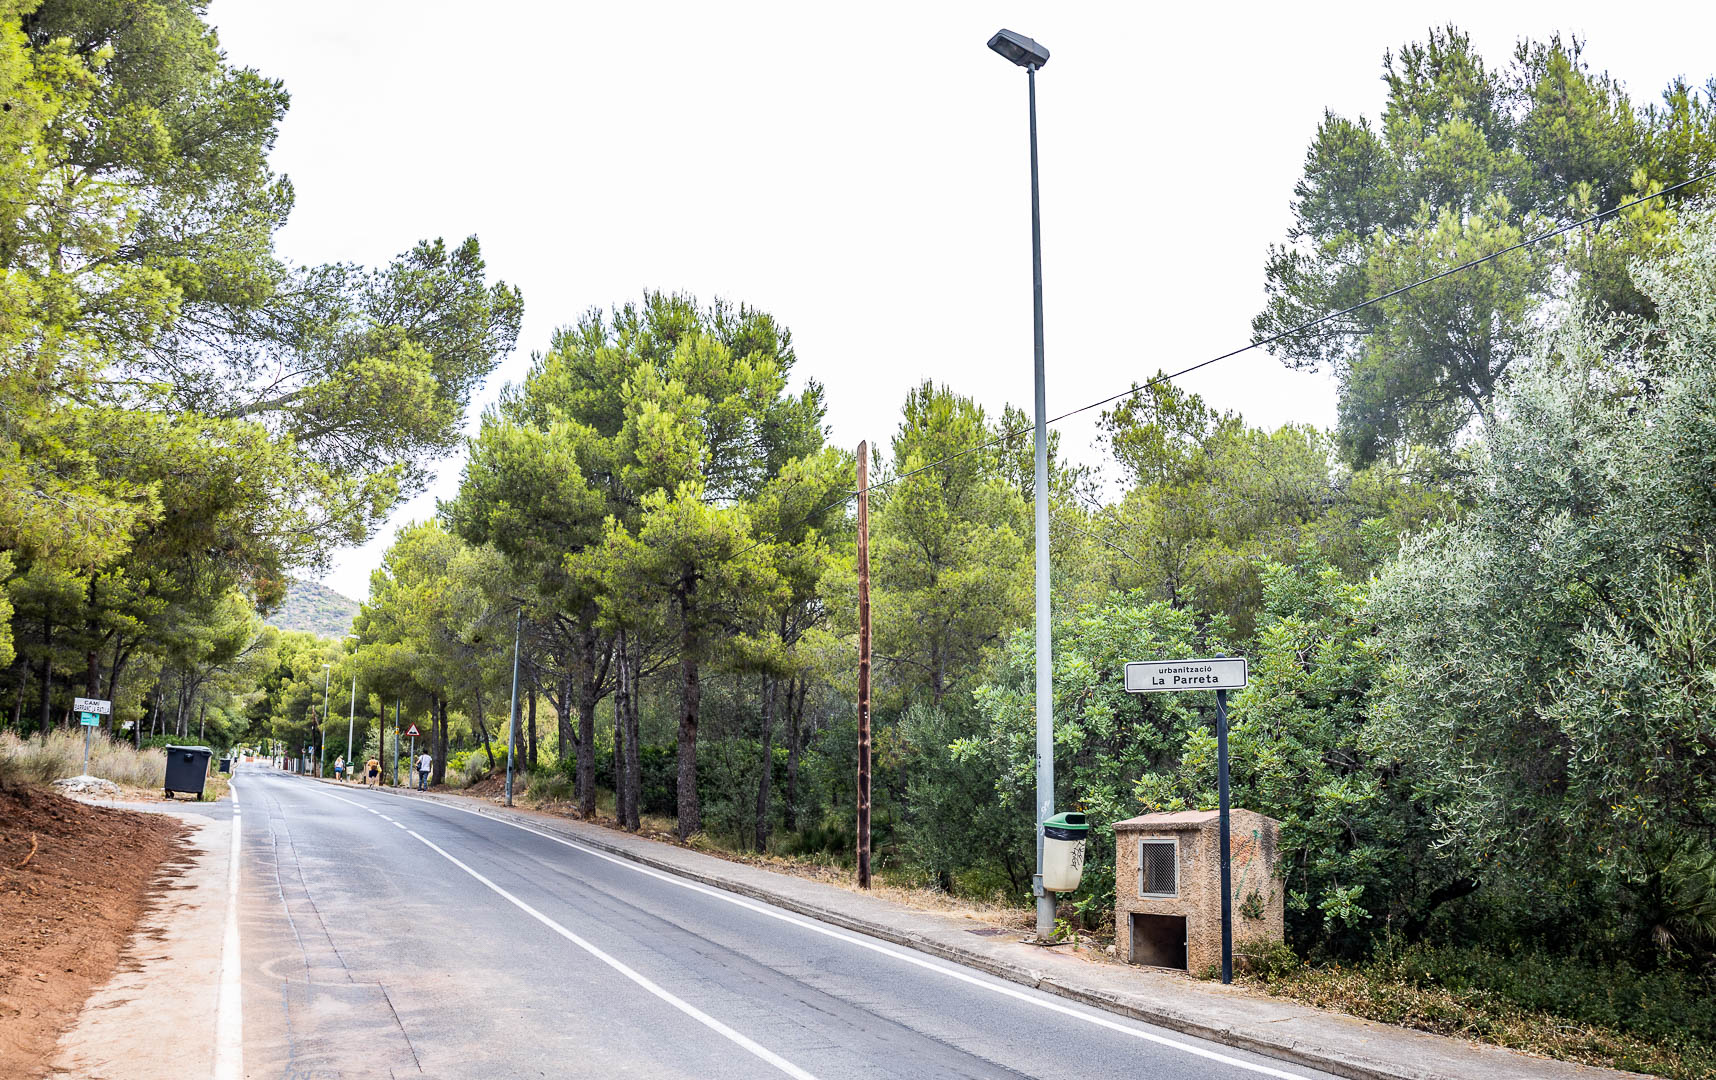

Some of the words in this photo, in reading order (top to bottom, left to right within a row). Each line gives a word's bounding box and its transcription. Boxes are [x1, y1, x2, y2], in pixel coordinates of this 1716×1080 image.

[1158, 665, 1212, 674] urbanització
[1152, 676, 1165, 685] La
[1173, 674, 1218, 685] Parreta
